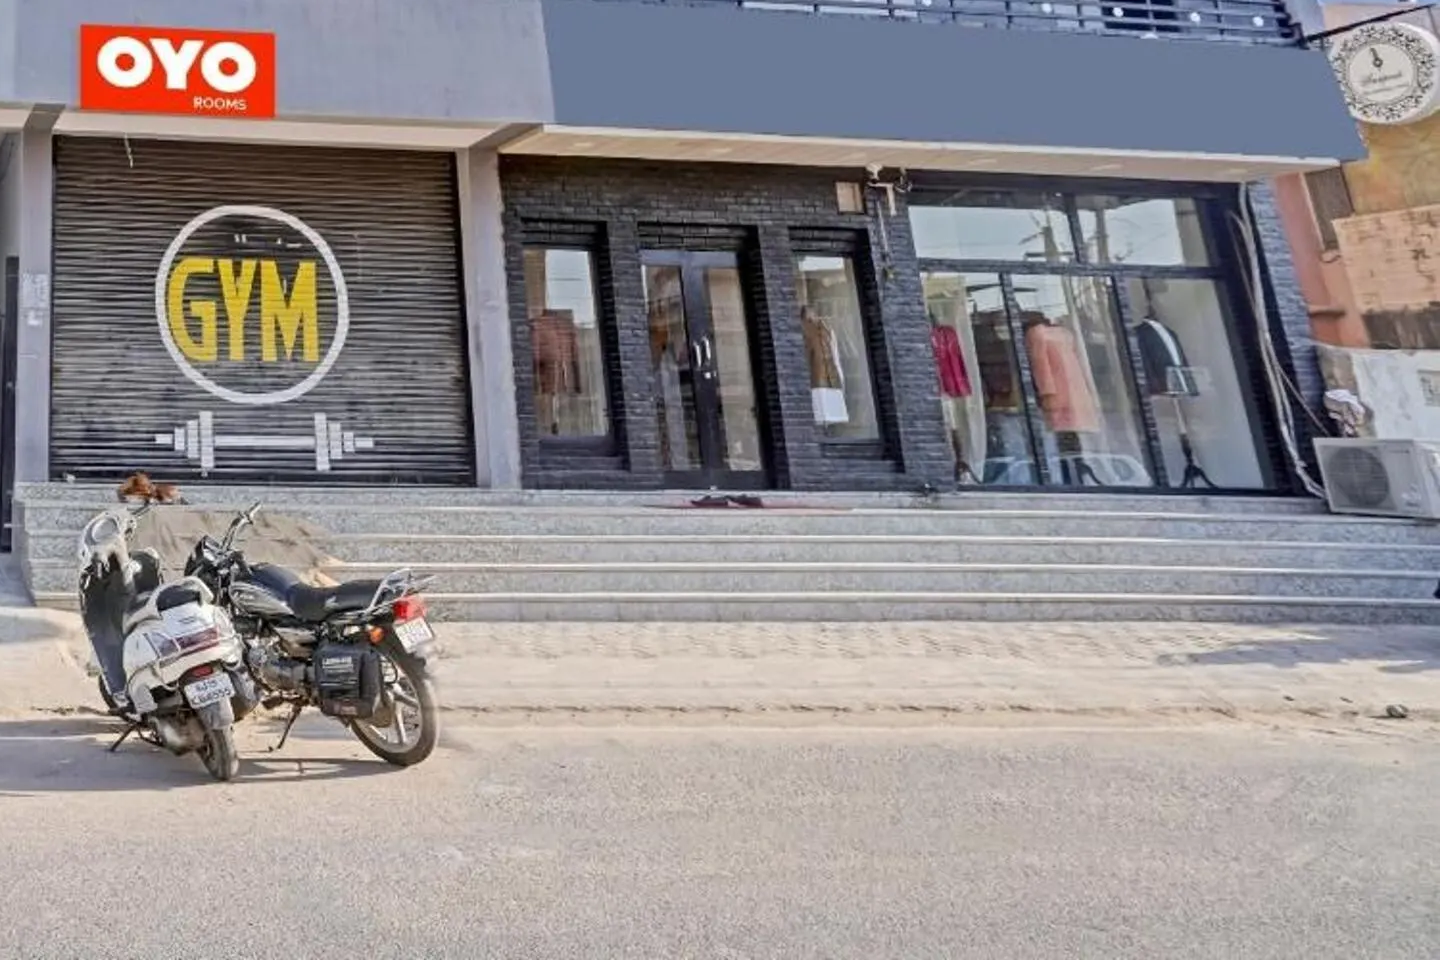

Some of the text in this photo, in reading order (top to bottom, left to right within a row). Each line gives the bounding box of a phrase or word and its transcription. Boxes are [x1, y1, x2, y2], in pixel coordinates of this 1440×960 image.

[97, 36, 257, 93] OYO
[193, 96, 247, 110] ROOMS
[168, 257, 319, 362] GYM
